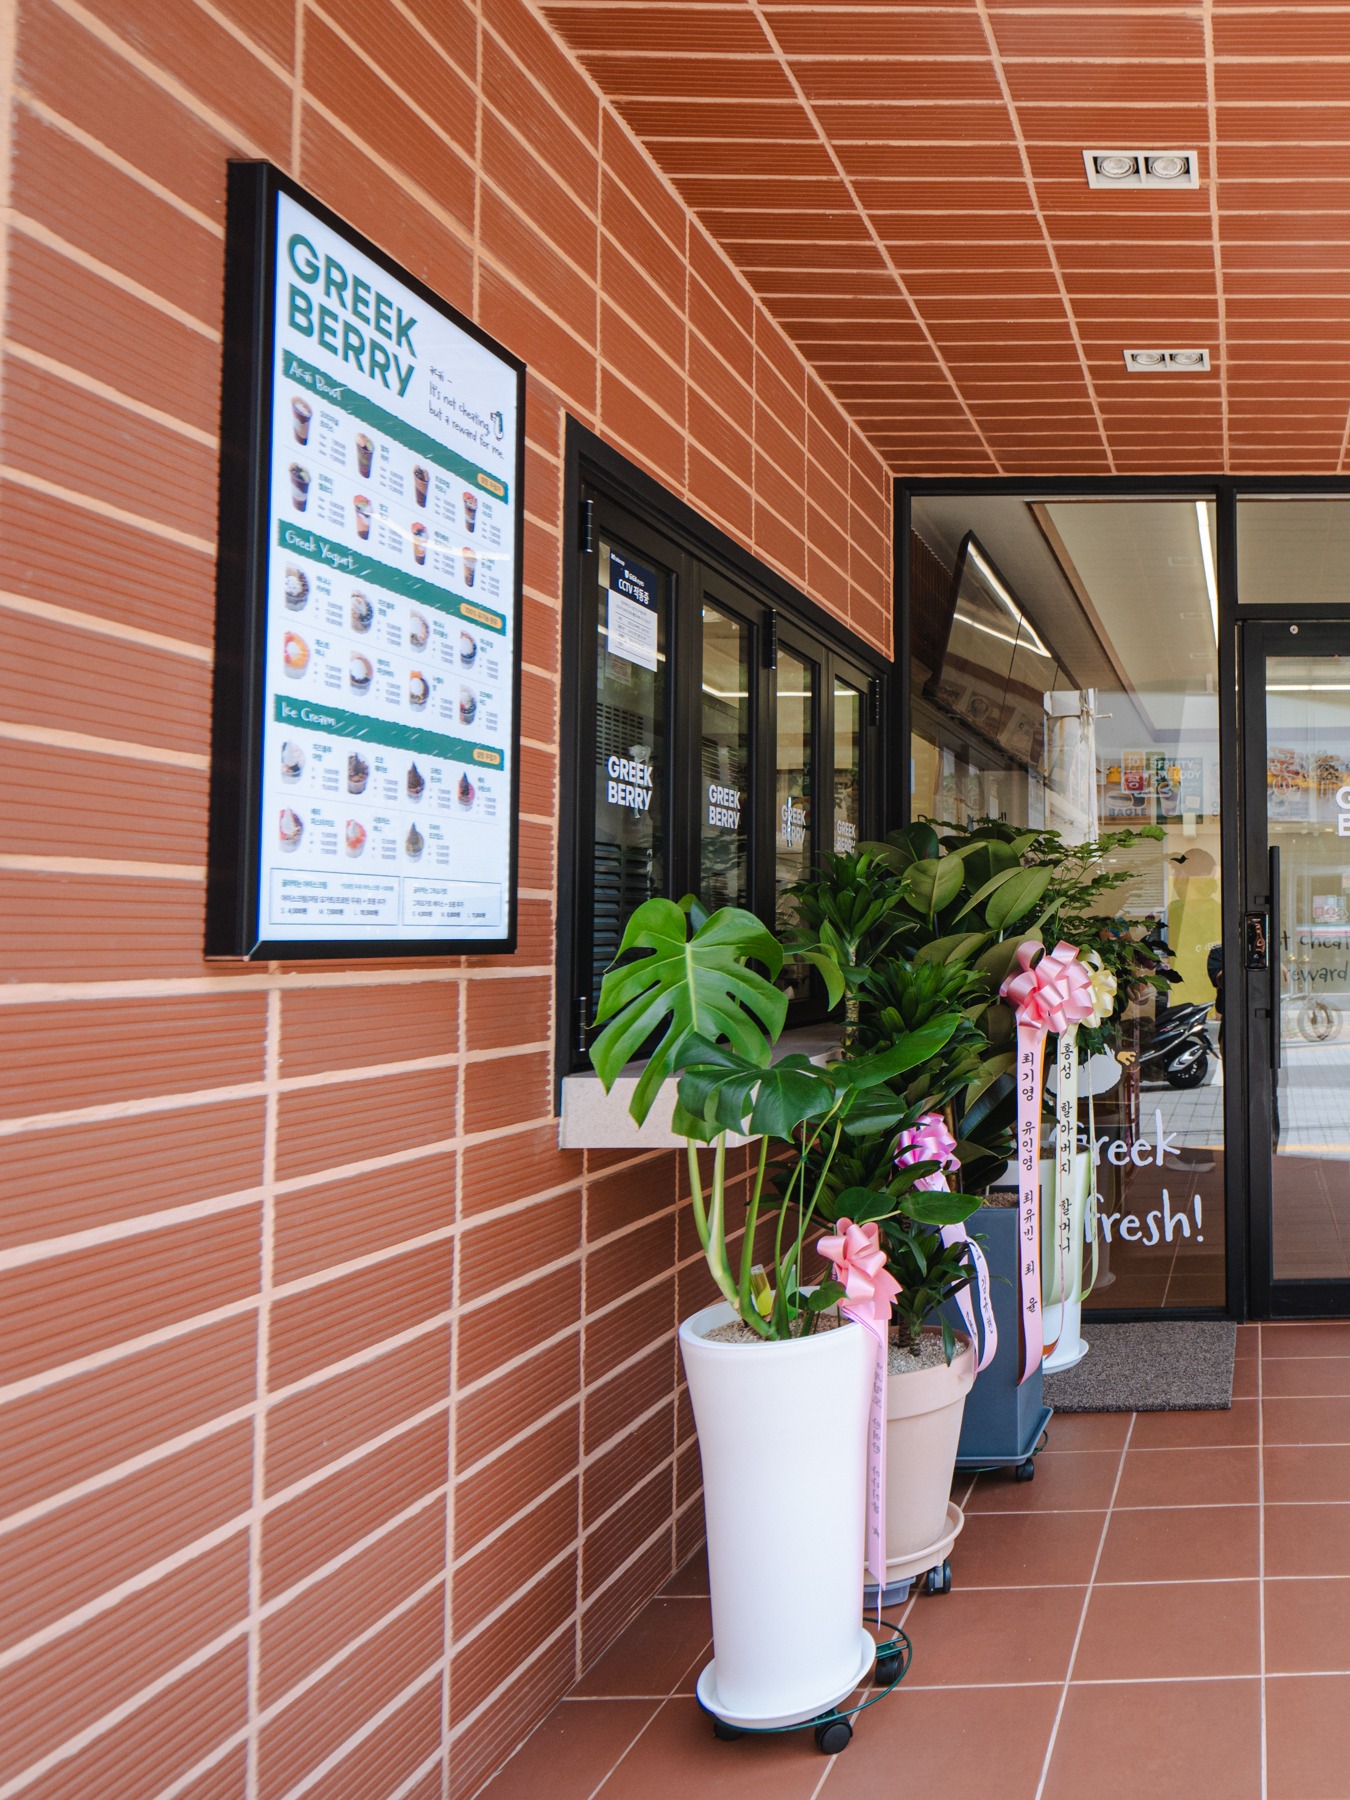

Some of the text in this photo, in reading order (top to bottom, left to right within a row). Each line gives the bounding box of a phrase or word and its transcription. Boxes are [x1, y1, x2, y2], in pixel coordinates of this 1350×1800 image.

[287, 233, 418, 359] GREEK
[288, 282, 415, 398] BERRY
[429, 381, 441, 400] It's
[443, 395, 456, 410] not
[428, 400, 442, 421] but
[445, 415, 450, 425] a
[452, 421, 477, 442] reward
[479, 435, 490, 450] for
[285, 529, 355, 569] Greek Yogurt
[618, 578, 633, 594] CCTV
[281, 702, 336, 726] Ice Cream
[607, 755, 653, 788] GREEK
[1159, 770, 1201, 780] MELODY
[607, 780, 653, 812] BERRY
[708, 783, 741, 810] GREEK
[708, 805, 741, 830] BERRY
[1108, 808, 1148, 817] BAGLE
[837, 820, 856, 838] GREEK
[1281, 960, 1348, 982] reward
[1021, 1051, 1035, 1103] 최기영
[1021, 1120, 1036, 1172] 유인영
[1058, 1041, 1074, 1254] 홍성 할아버지 할머니
[1022, 1189, 1036, 1242] 최유빈
[1084, 1188, 1204, 1246] fresh!
